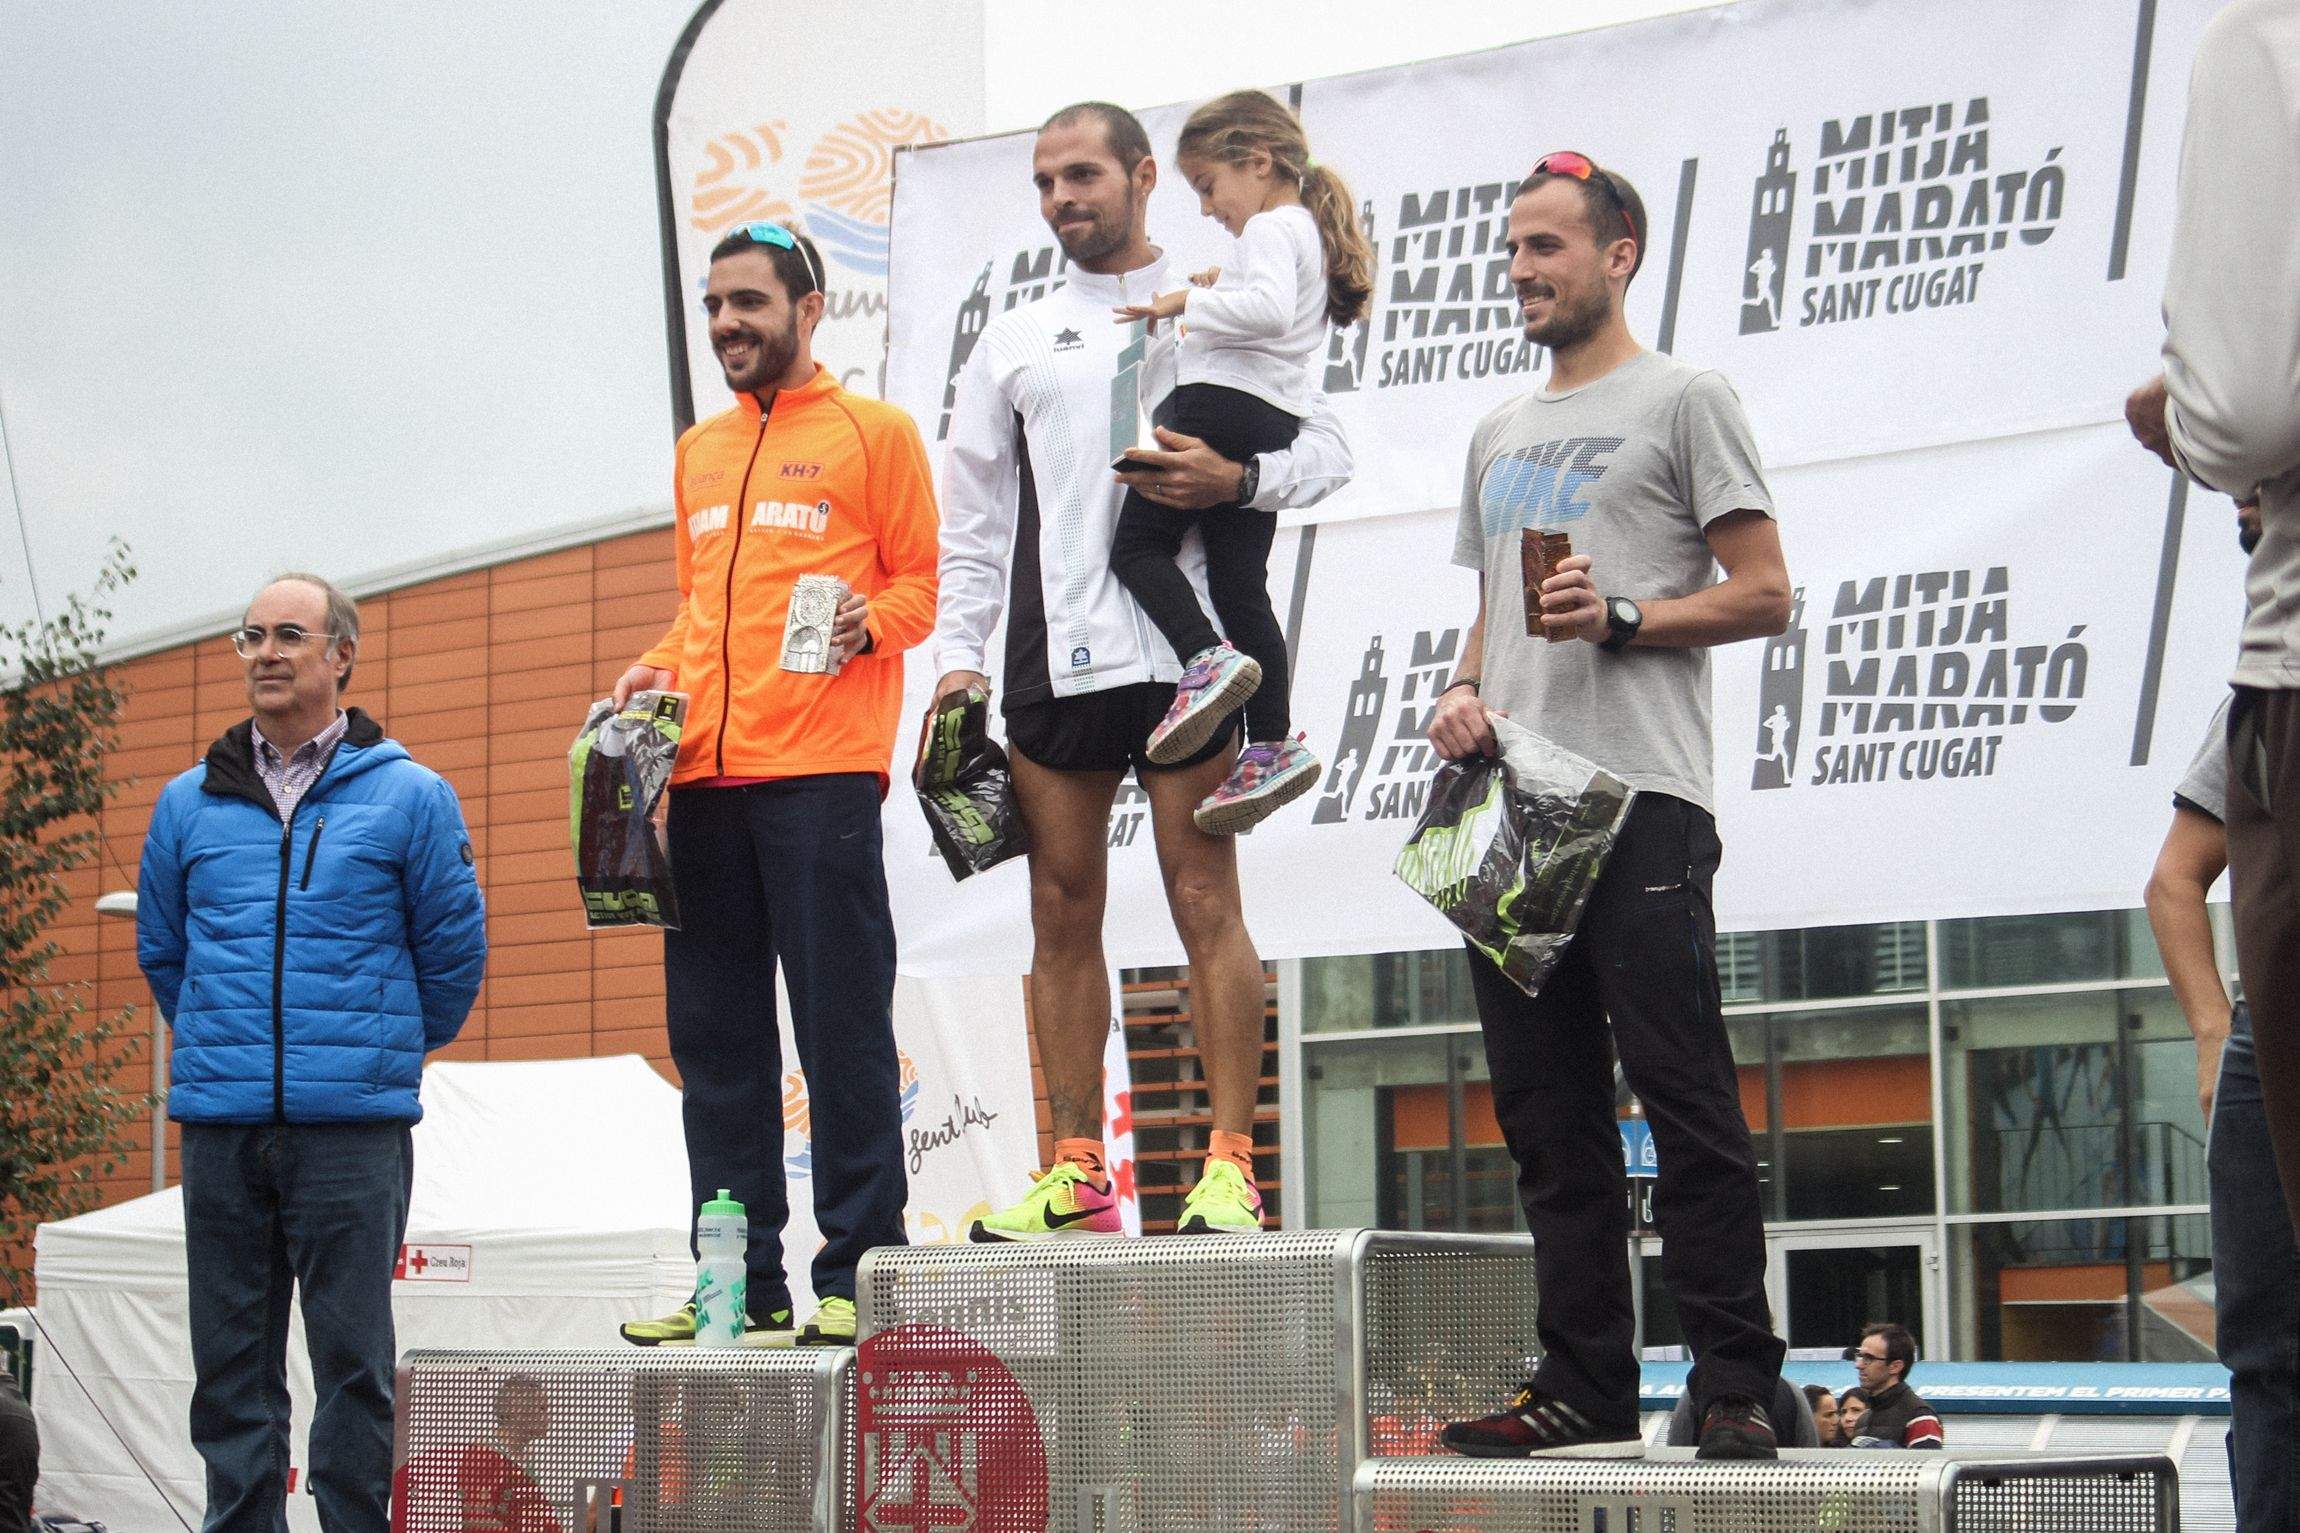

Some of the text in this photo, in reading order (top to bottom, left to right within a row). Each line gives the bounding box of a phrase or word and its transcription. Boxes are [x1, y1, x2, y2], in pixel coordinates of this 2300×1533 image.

[1813, 97, 1989, 196] MITJA
[1804, 146, 2065, 278] MARATÓ
[1800, 262, 1984, 328] SANT CUGAT
[1378, 344, 1454, 389] SANT
[1825, 566, 2009, 655] MITJA
[1818, 624, 2089, 737] MARATÓ
[1811, 735, 2003, 786] SANT CUGAT
[1365, 779, 1431, 821] SAN
[1917, 1385, 2065, 1399] PRESENTEM
[2067, 1386, 2100, 1398] EL
[2104, 1386, 2204, 1399] PRIMER
